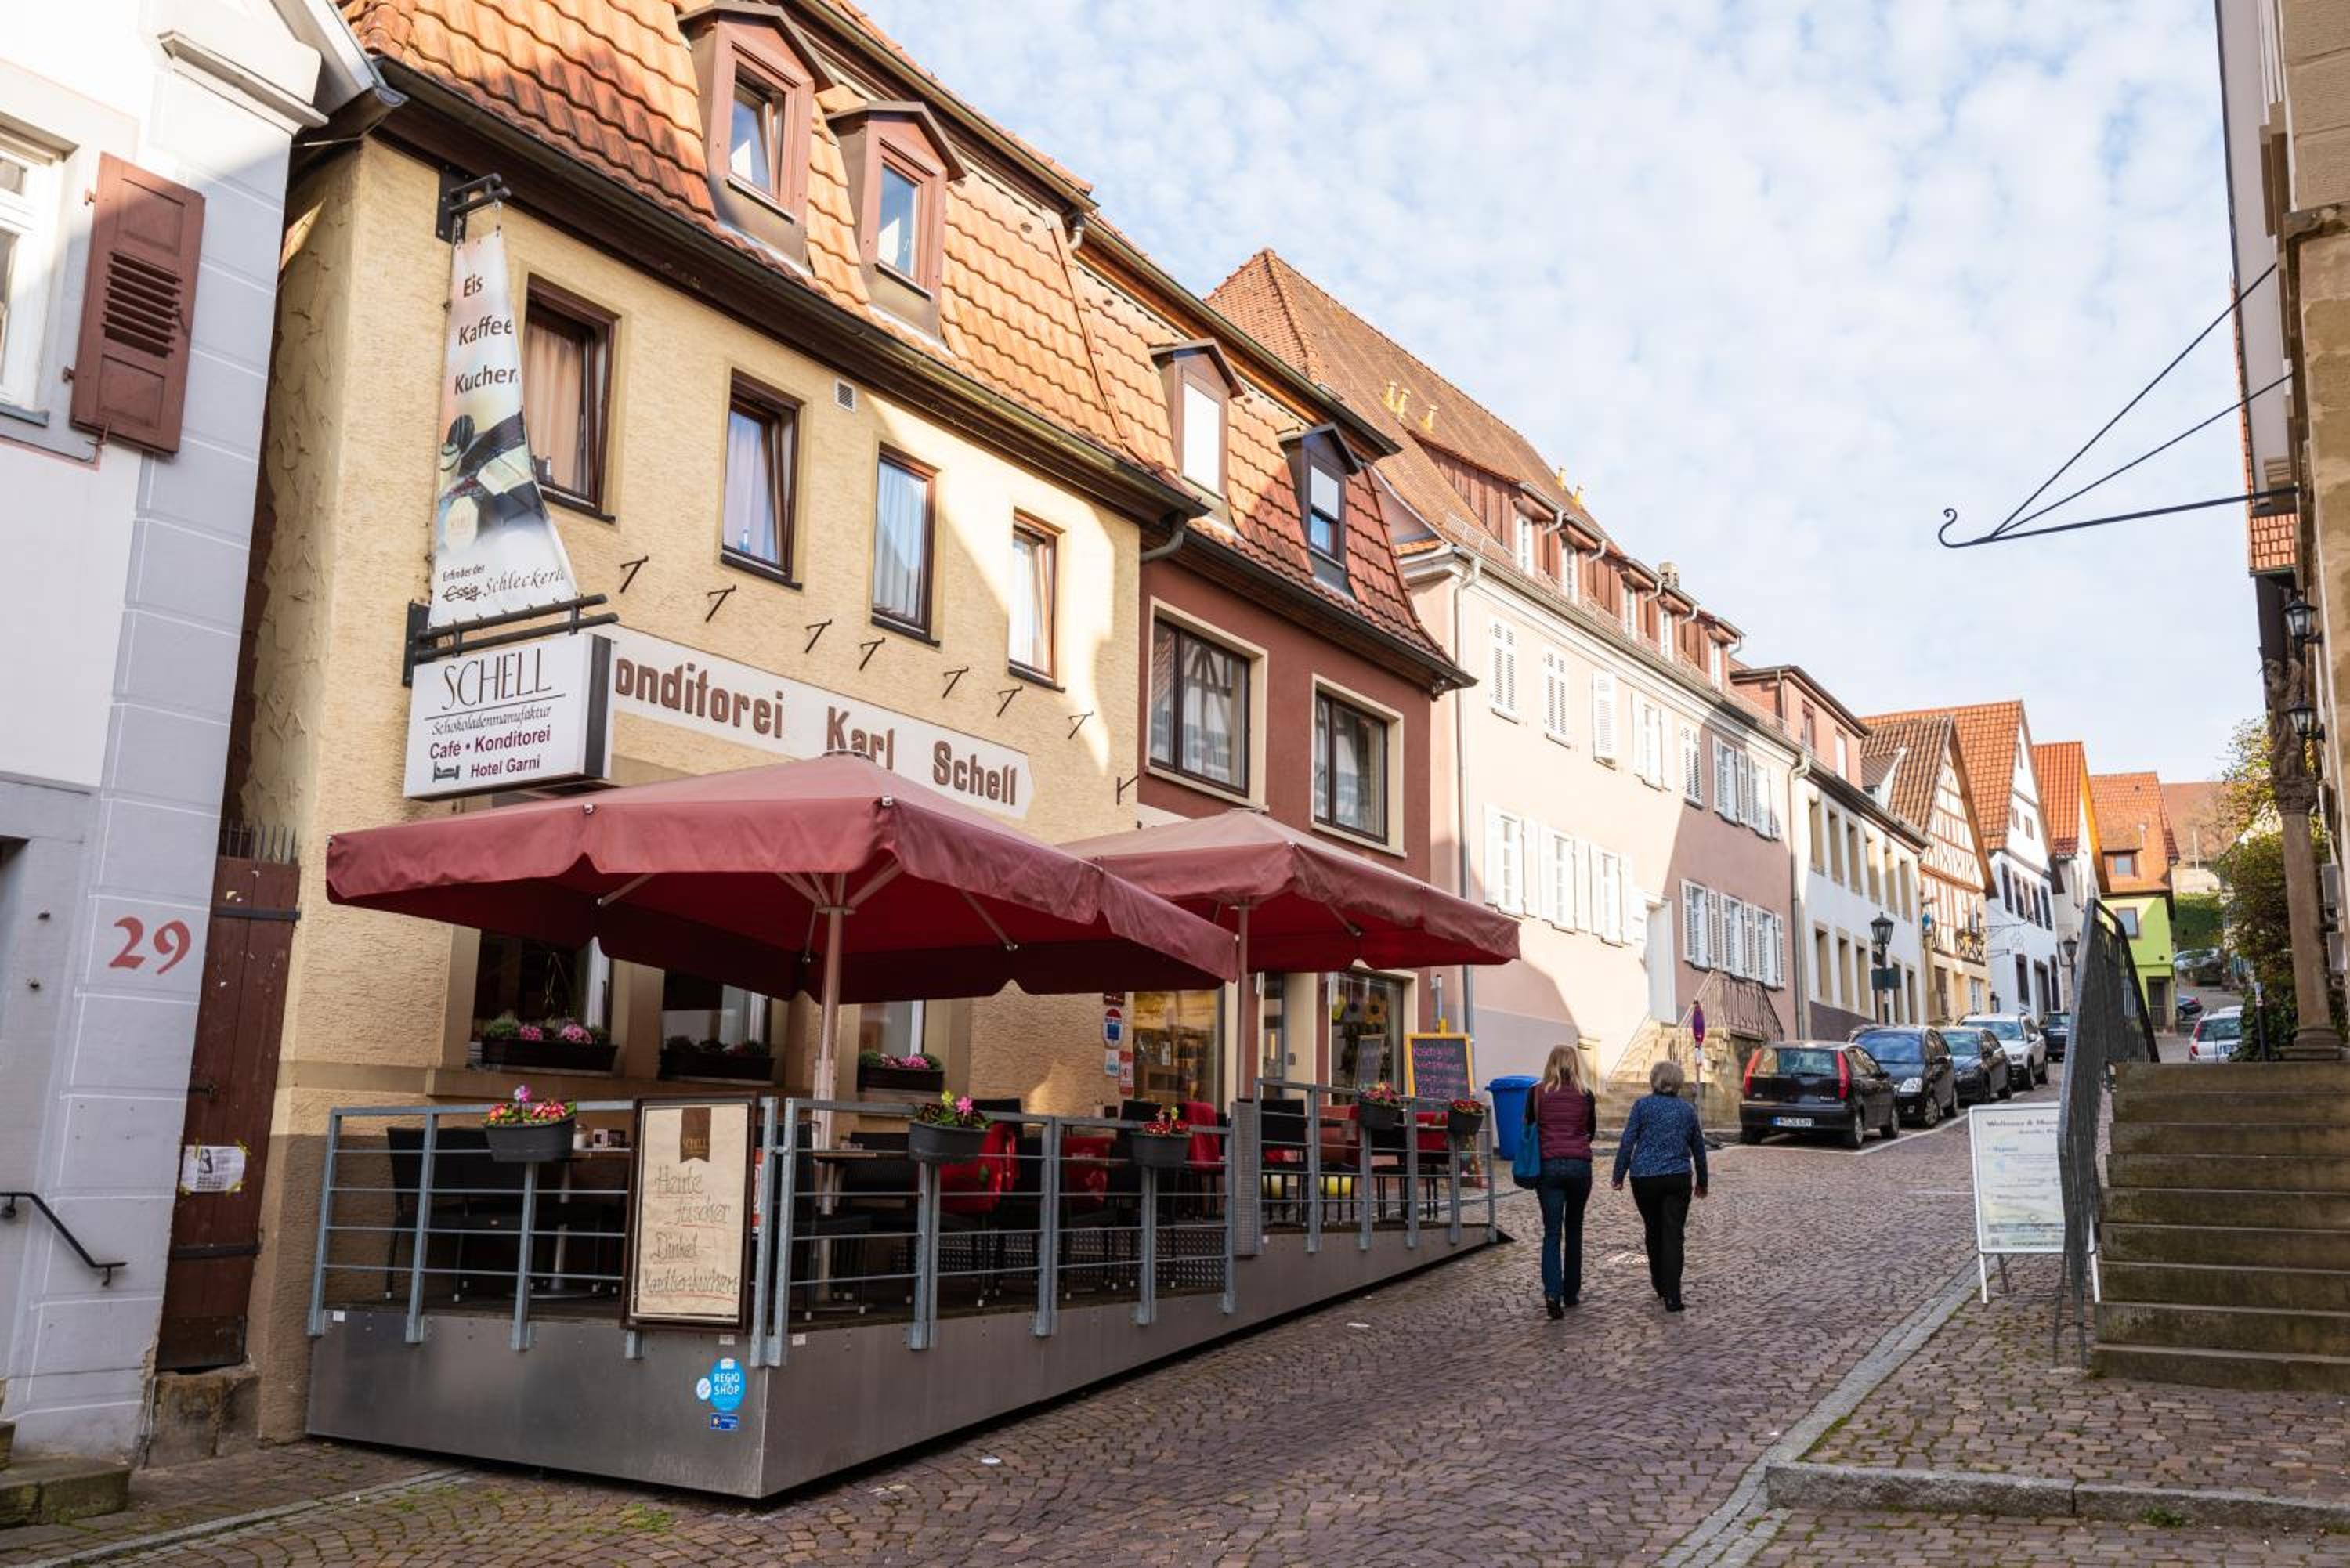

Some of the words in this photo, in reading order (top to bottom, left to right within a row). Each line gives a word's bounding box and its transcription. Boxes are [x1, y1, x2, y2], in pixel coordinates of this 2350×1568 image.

[464, 274, 483, 298] Eis
[458, 315, 513, 347] Kaffee
[472, 564, 485, 575] der
[441, 648, 552, 710] SCHELL
[432, 704, 552, 736] Schokoladenmanufaktur
[615, 658, 784, 739] onditorei
[826, 706, 895, 771] Karl
[933, 740, 1017, 806] Schell
[429, 740, 461, 760] Café
[474, 724, 551, 753] Konditorei
[470, 759, 502, 778] Hotel
[506, 753, 540, 774] Garni
[109, 917, 191, 975] 29
[714, 1373, 740, 1383] REGIO
[714, 1384, 740, 1395] SHOP
